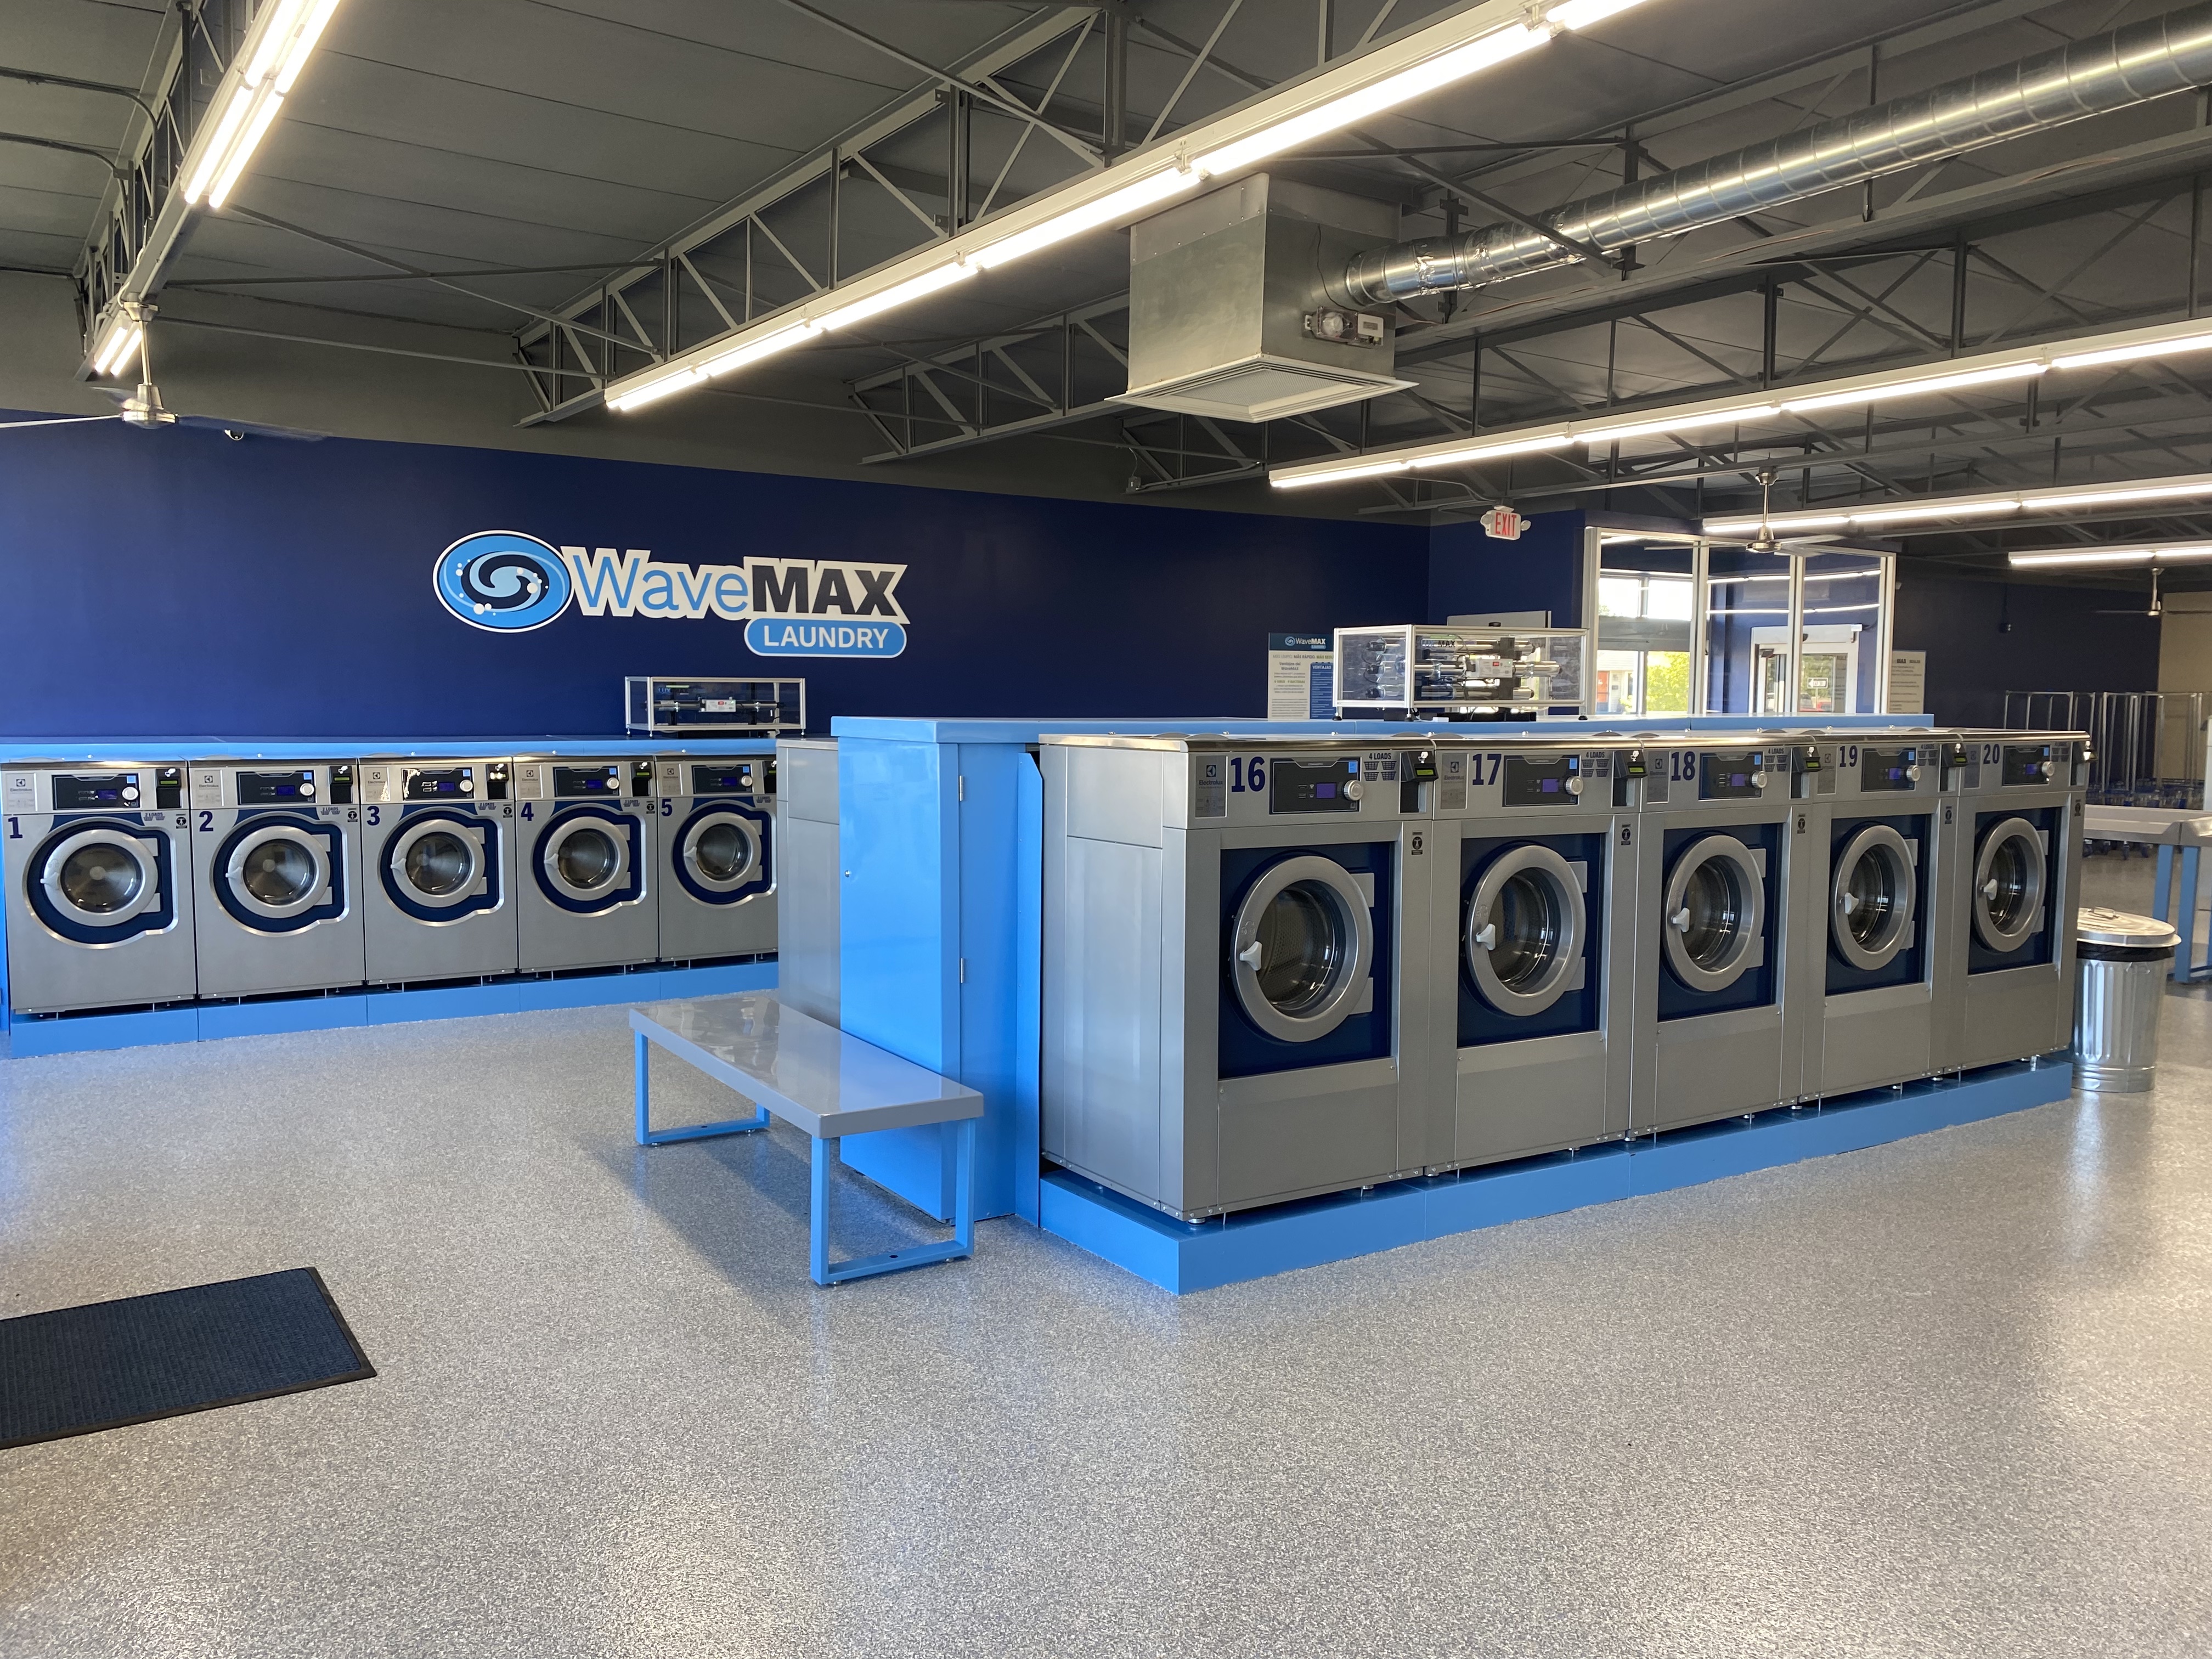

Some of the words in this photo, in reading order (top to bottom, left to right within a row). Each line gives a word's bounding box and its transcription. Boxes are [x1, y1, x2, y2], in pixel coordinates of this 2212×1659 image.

[1496, 512, 1517, 537] EXIT
[572, 554, 899, 616] WaveMAX
[764, 625, 889, 648] LAUNDRY
[1839, 745, 1858, 767] 19
[1983, 744, 2000, 764] 20
[1231, 756, 1266, 793] 16
[1472, 753, 1502, 786] 17
[1671, 751, 1696, 781] 18
[366, 806, 380, 826] 3
[521, 802, 534, 821] 4
[661, 798, 673, 817] 5
[7, 817, 23, 839] 1
[199, 811, 214, 832] 2
